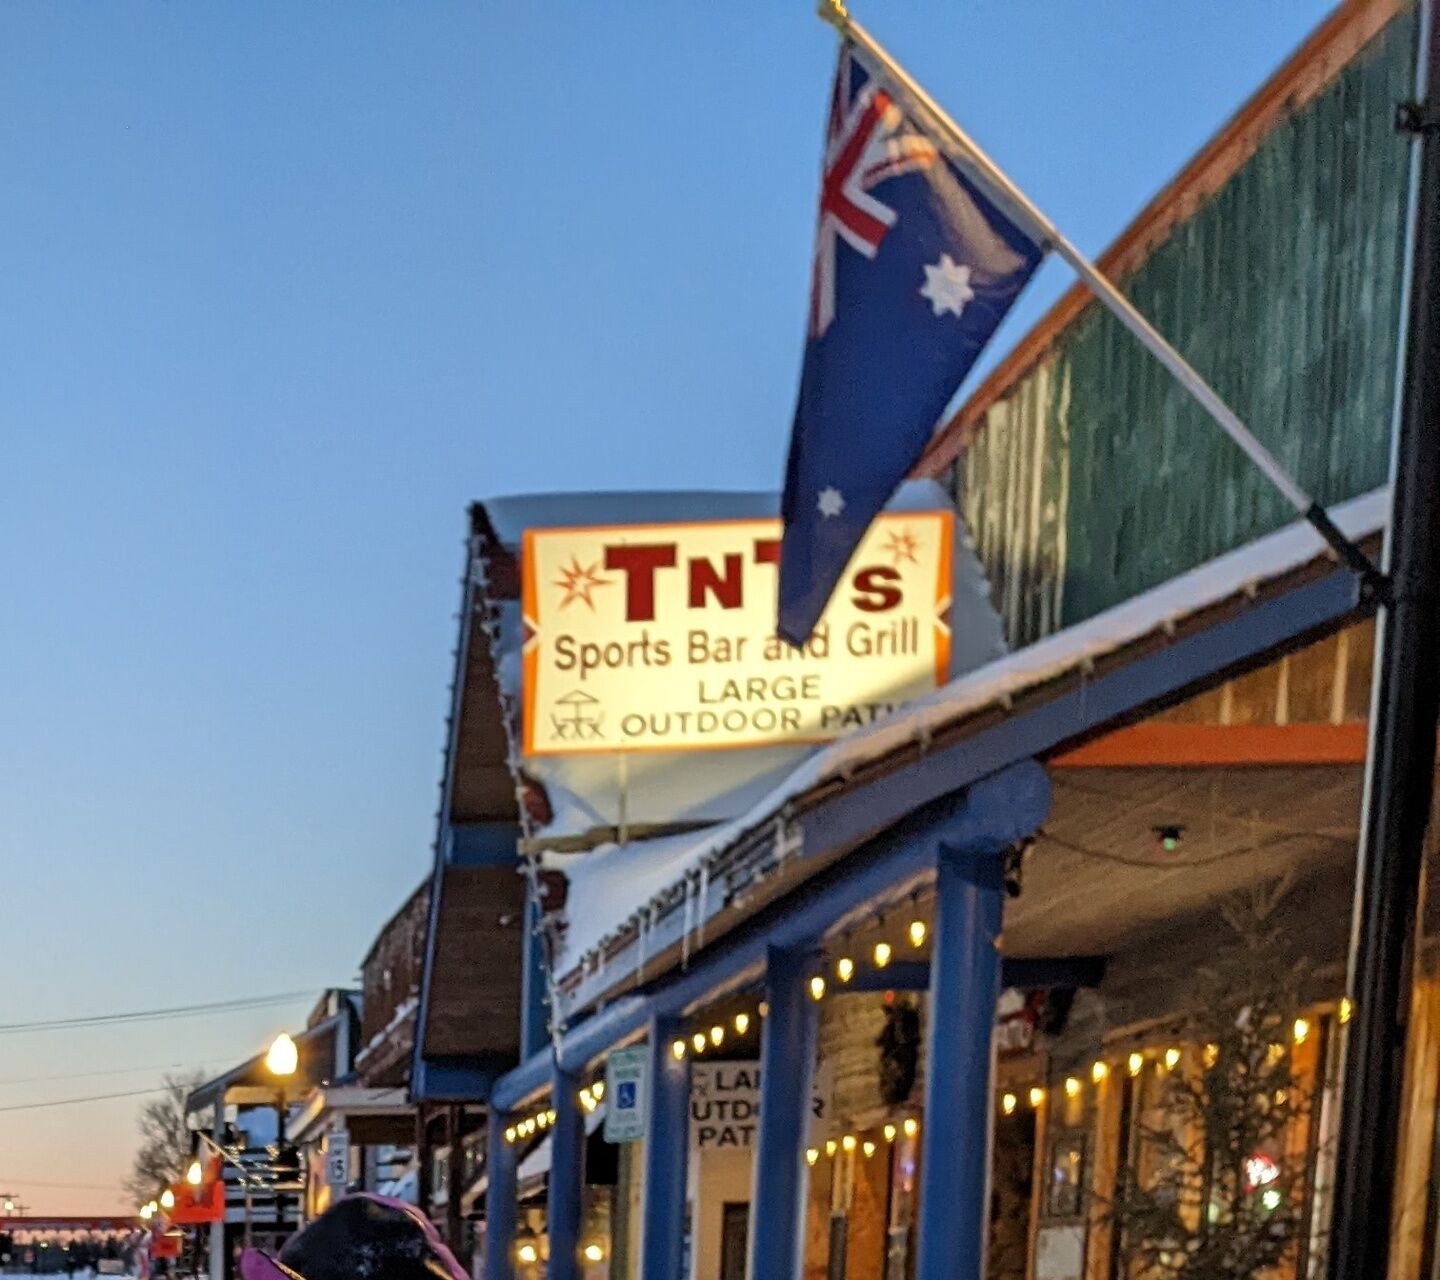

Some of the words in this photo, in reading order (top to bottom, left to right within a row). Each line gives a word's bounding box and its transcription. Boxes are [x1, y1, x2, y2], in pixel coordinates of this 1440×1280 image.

[554, 628, 672, 681] Sports
[687, 629, 747, 665] Bar
[846, 617, 919, 658] Grill
[698, 674, 822, 704] LARGE
[620, 706, 802, 737] OUTDOOR
